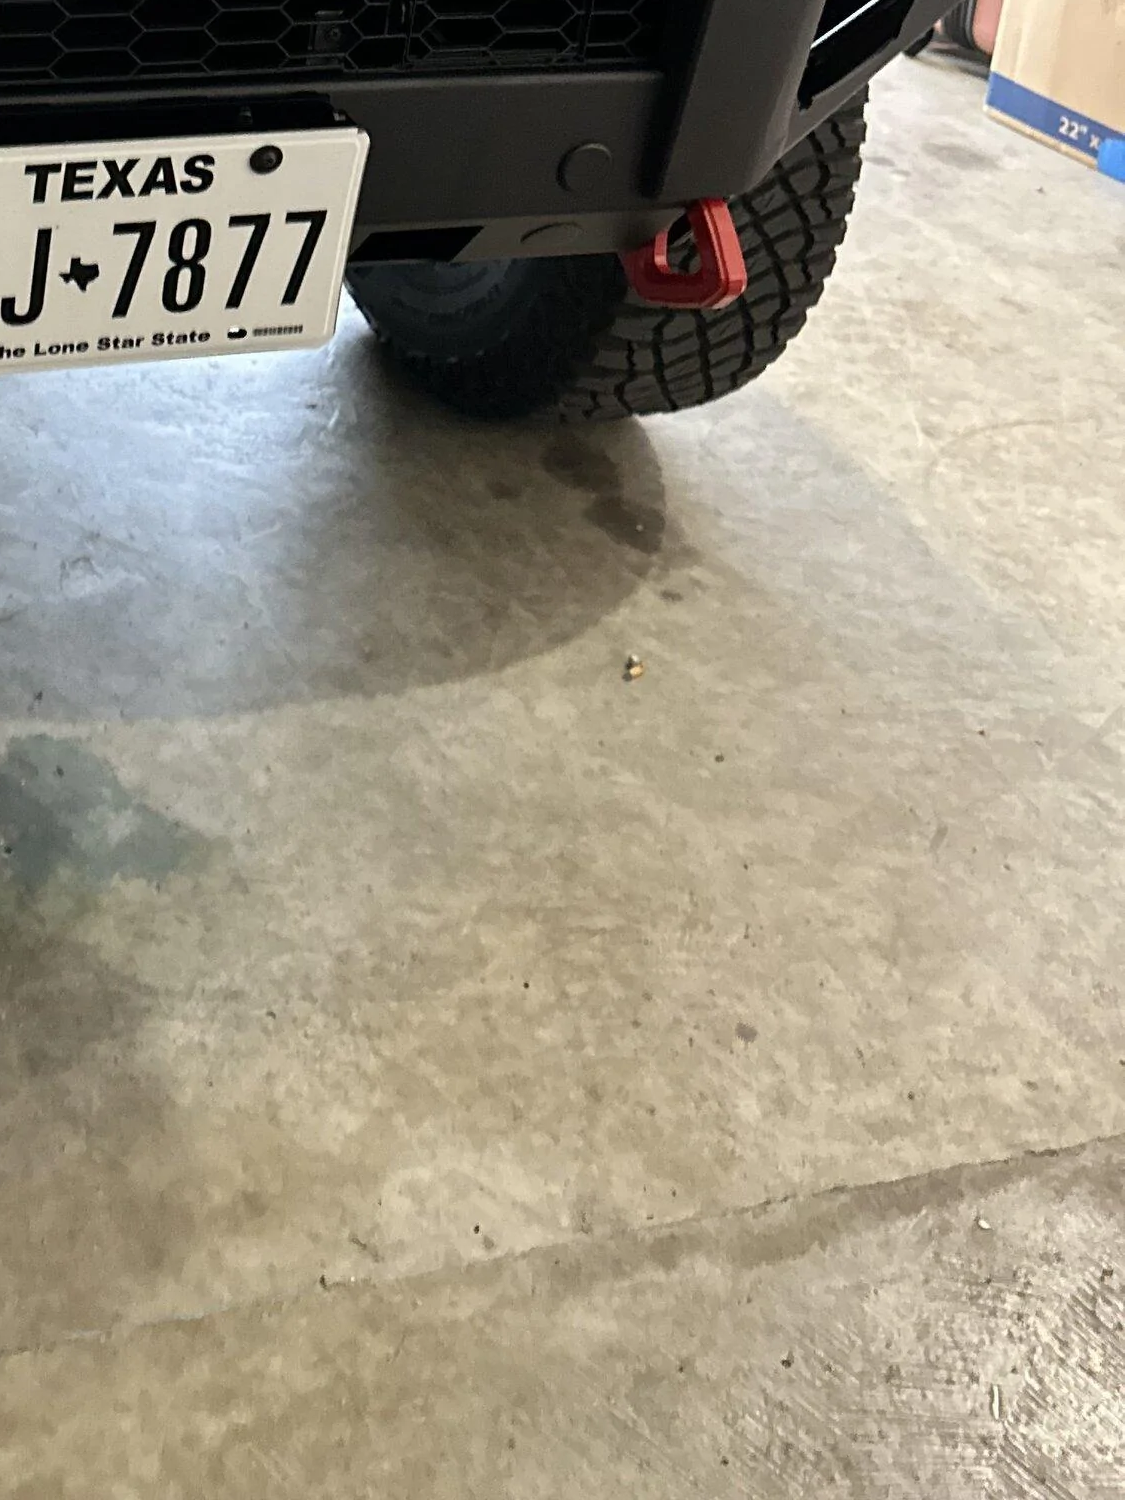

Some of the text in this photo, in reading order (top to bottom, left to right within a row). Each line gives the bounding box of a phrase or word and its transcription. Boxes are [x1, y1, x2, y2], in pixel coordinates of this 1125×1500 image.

[1058, 115, 1088, 141] 22"
[24, 154, 216, 204] TEXAS
[112, 210, 328, 320] 7877
[33, 340, 90, 356] Lone
[97, 334, 145, 352] Star
[151, 329, 211, 347] State
